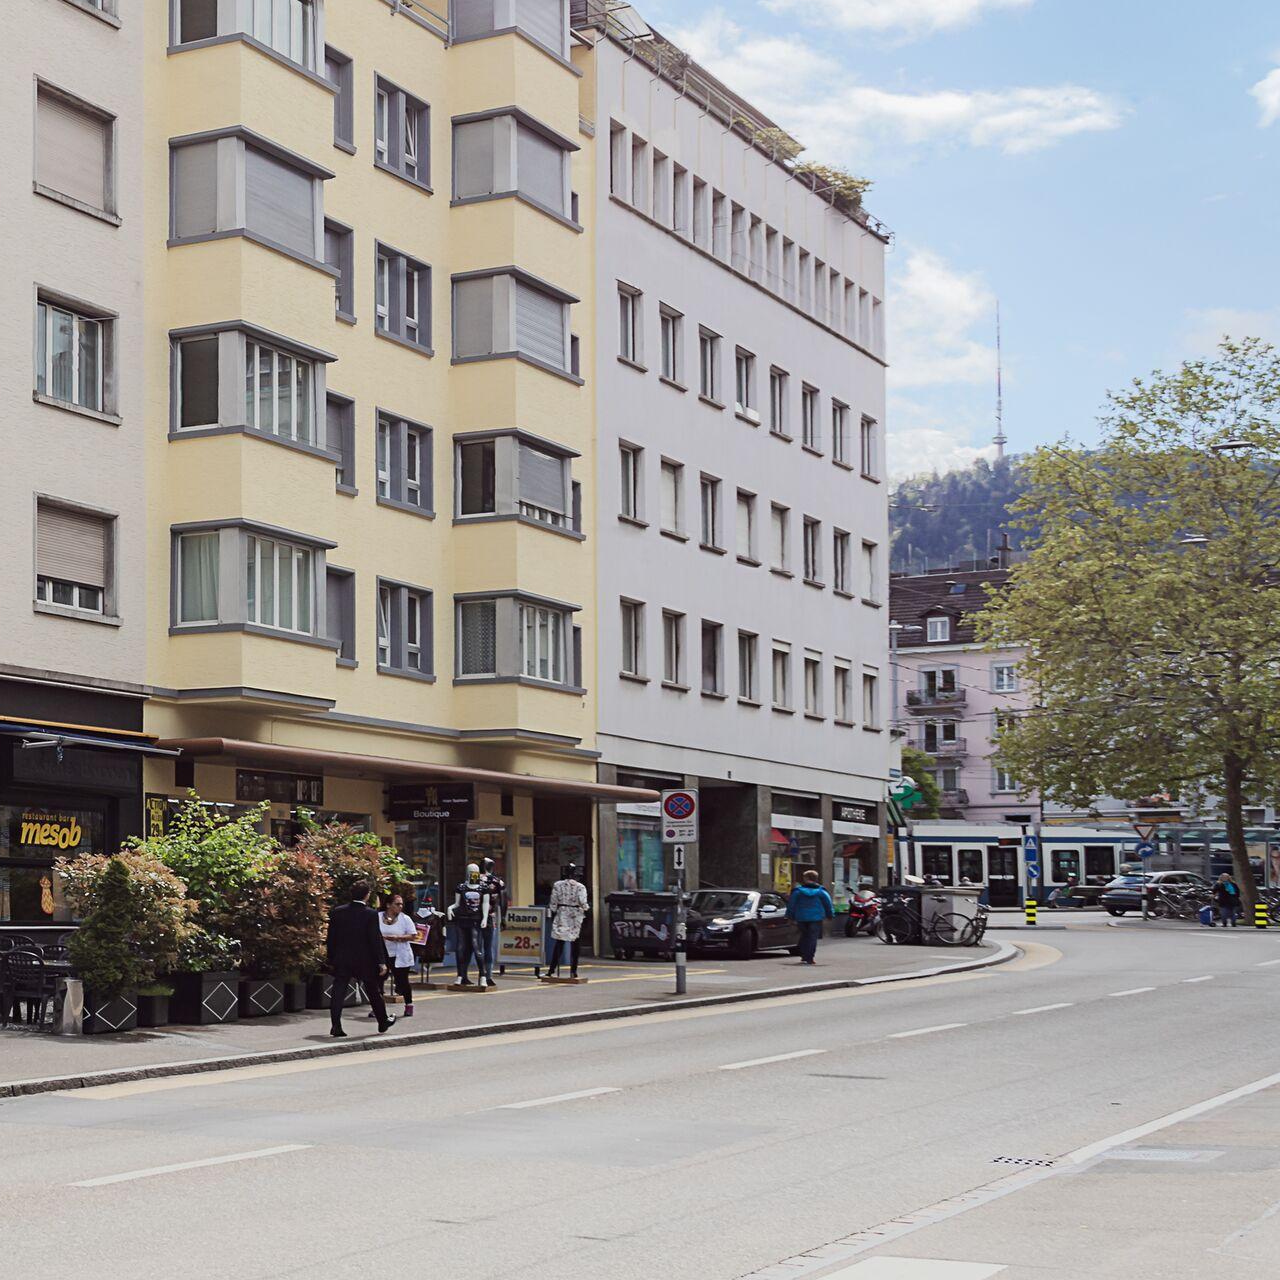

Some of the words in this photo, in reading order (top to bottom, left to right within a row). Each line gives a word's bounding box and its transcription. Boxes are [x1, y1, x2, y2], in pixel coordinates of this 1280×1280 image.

[22, 813, 57, 821] restaurant
[58, 813, 70, 822] bar
[413, 810, 450, 818] Boutique
[20, 816, 82, 849] mesob
[507, 913, 538, 923] Haare
[514, 936, 539, 949] 28.-
